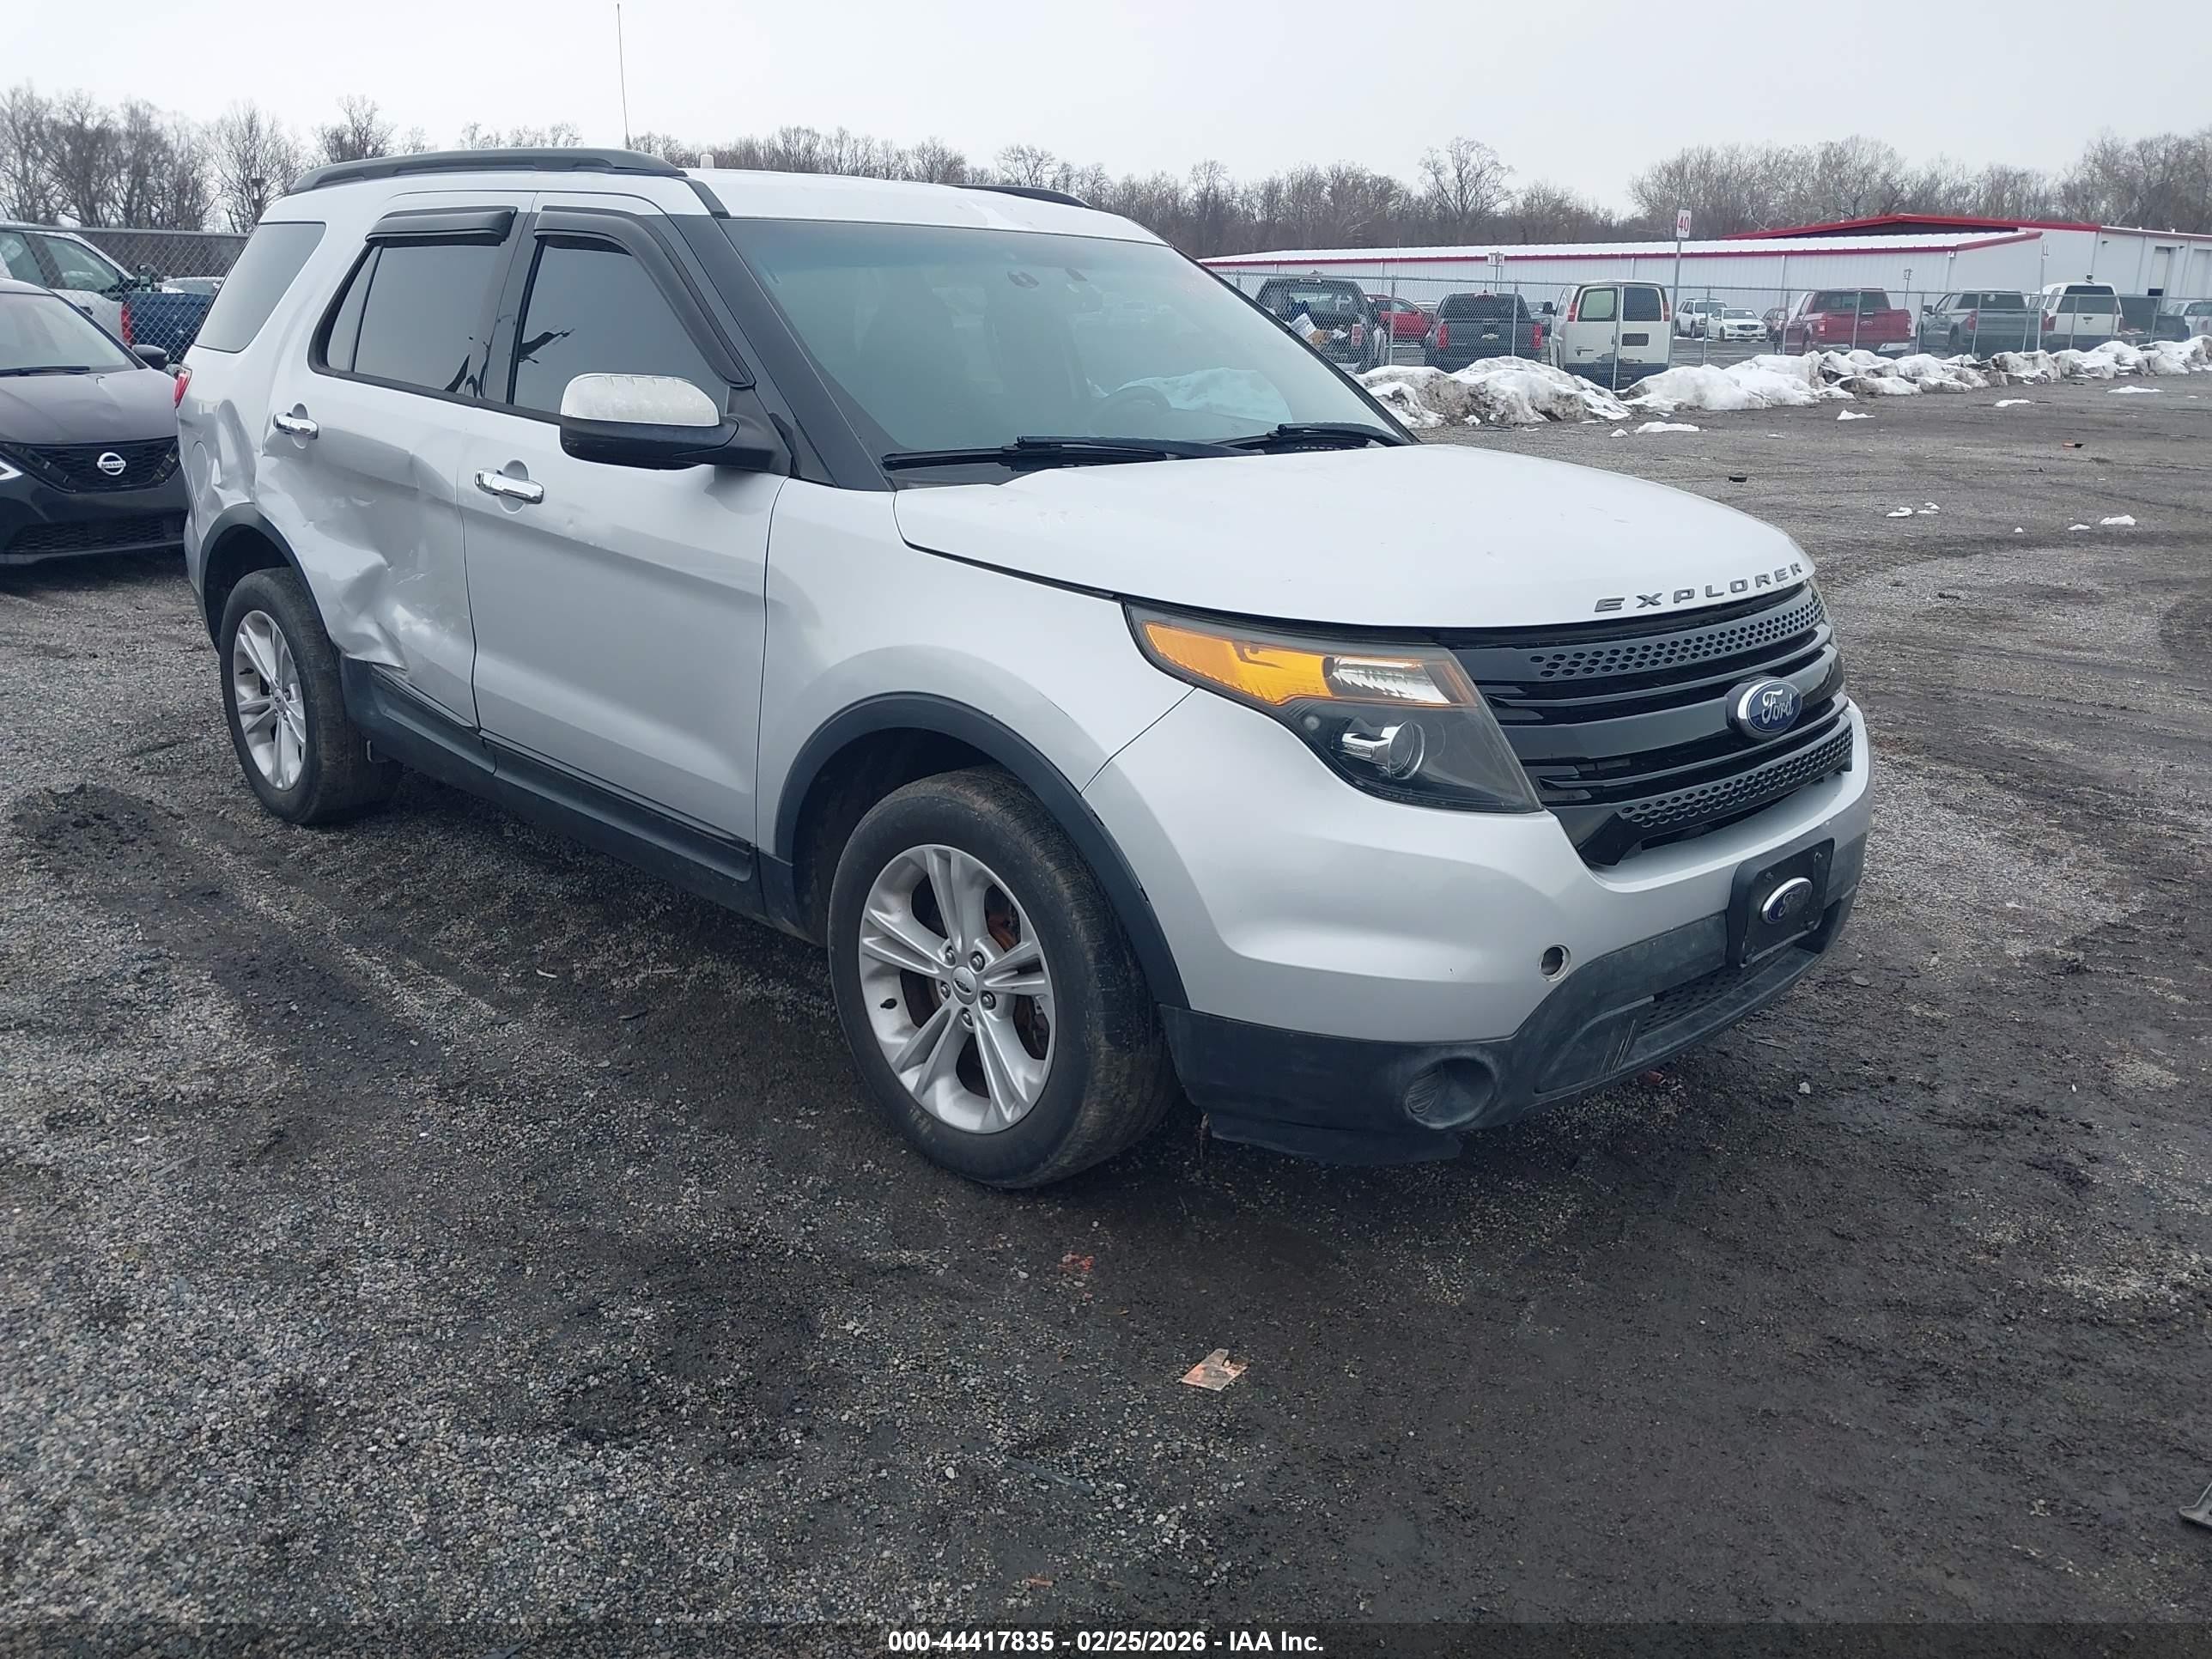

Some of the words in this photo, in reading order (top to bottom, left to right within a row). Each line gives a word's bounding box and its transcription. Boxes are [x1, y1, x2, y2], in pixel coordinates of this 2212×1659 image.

[1678, 216, 1690, 232] 40
[1594, 562, 1803, 612] EXPLORER
[1761, 689, 1794, 724] Ford
